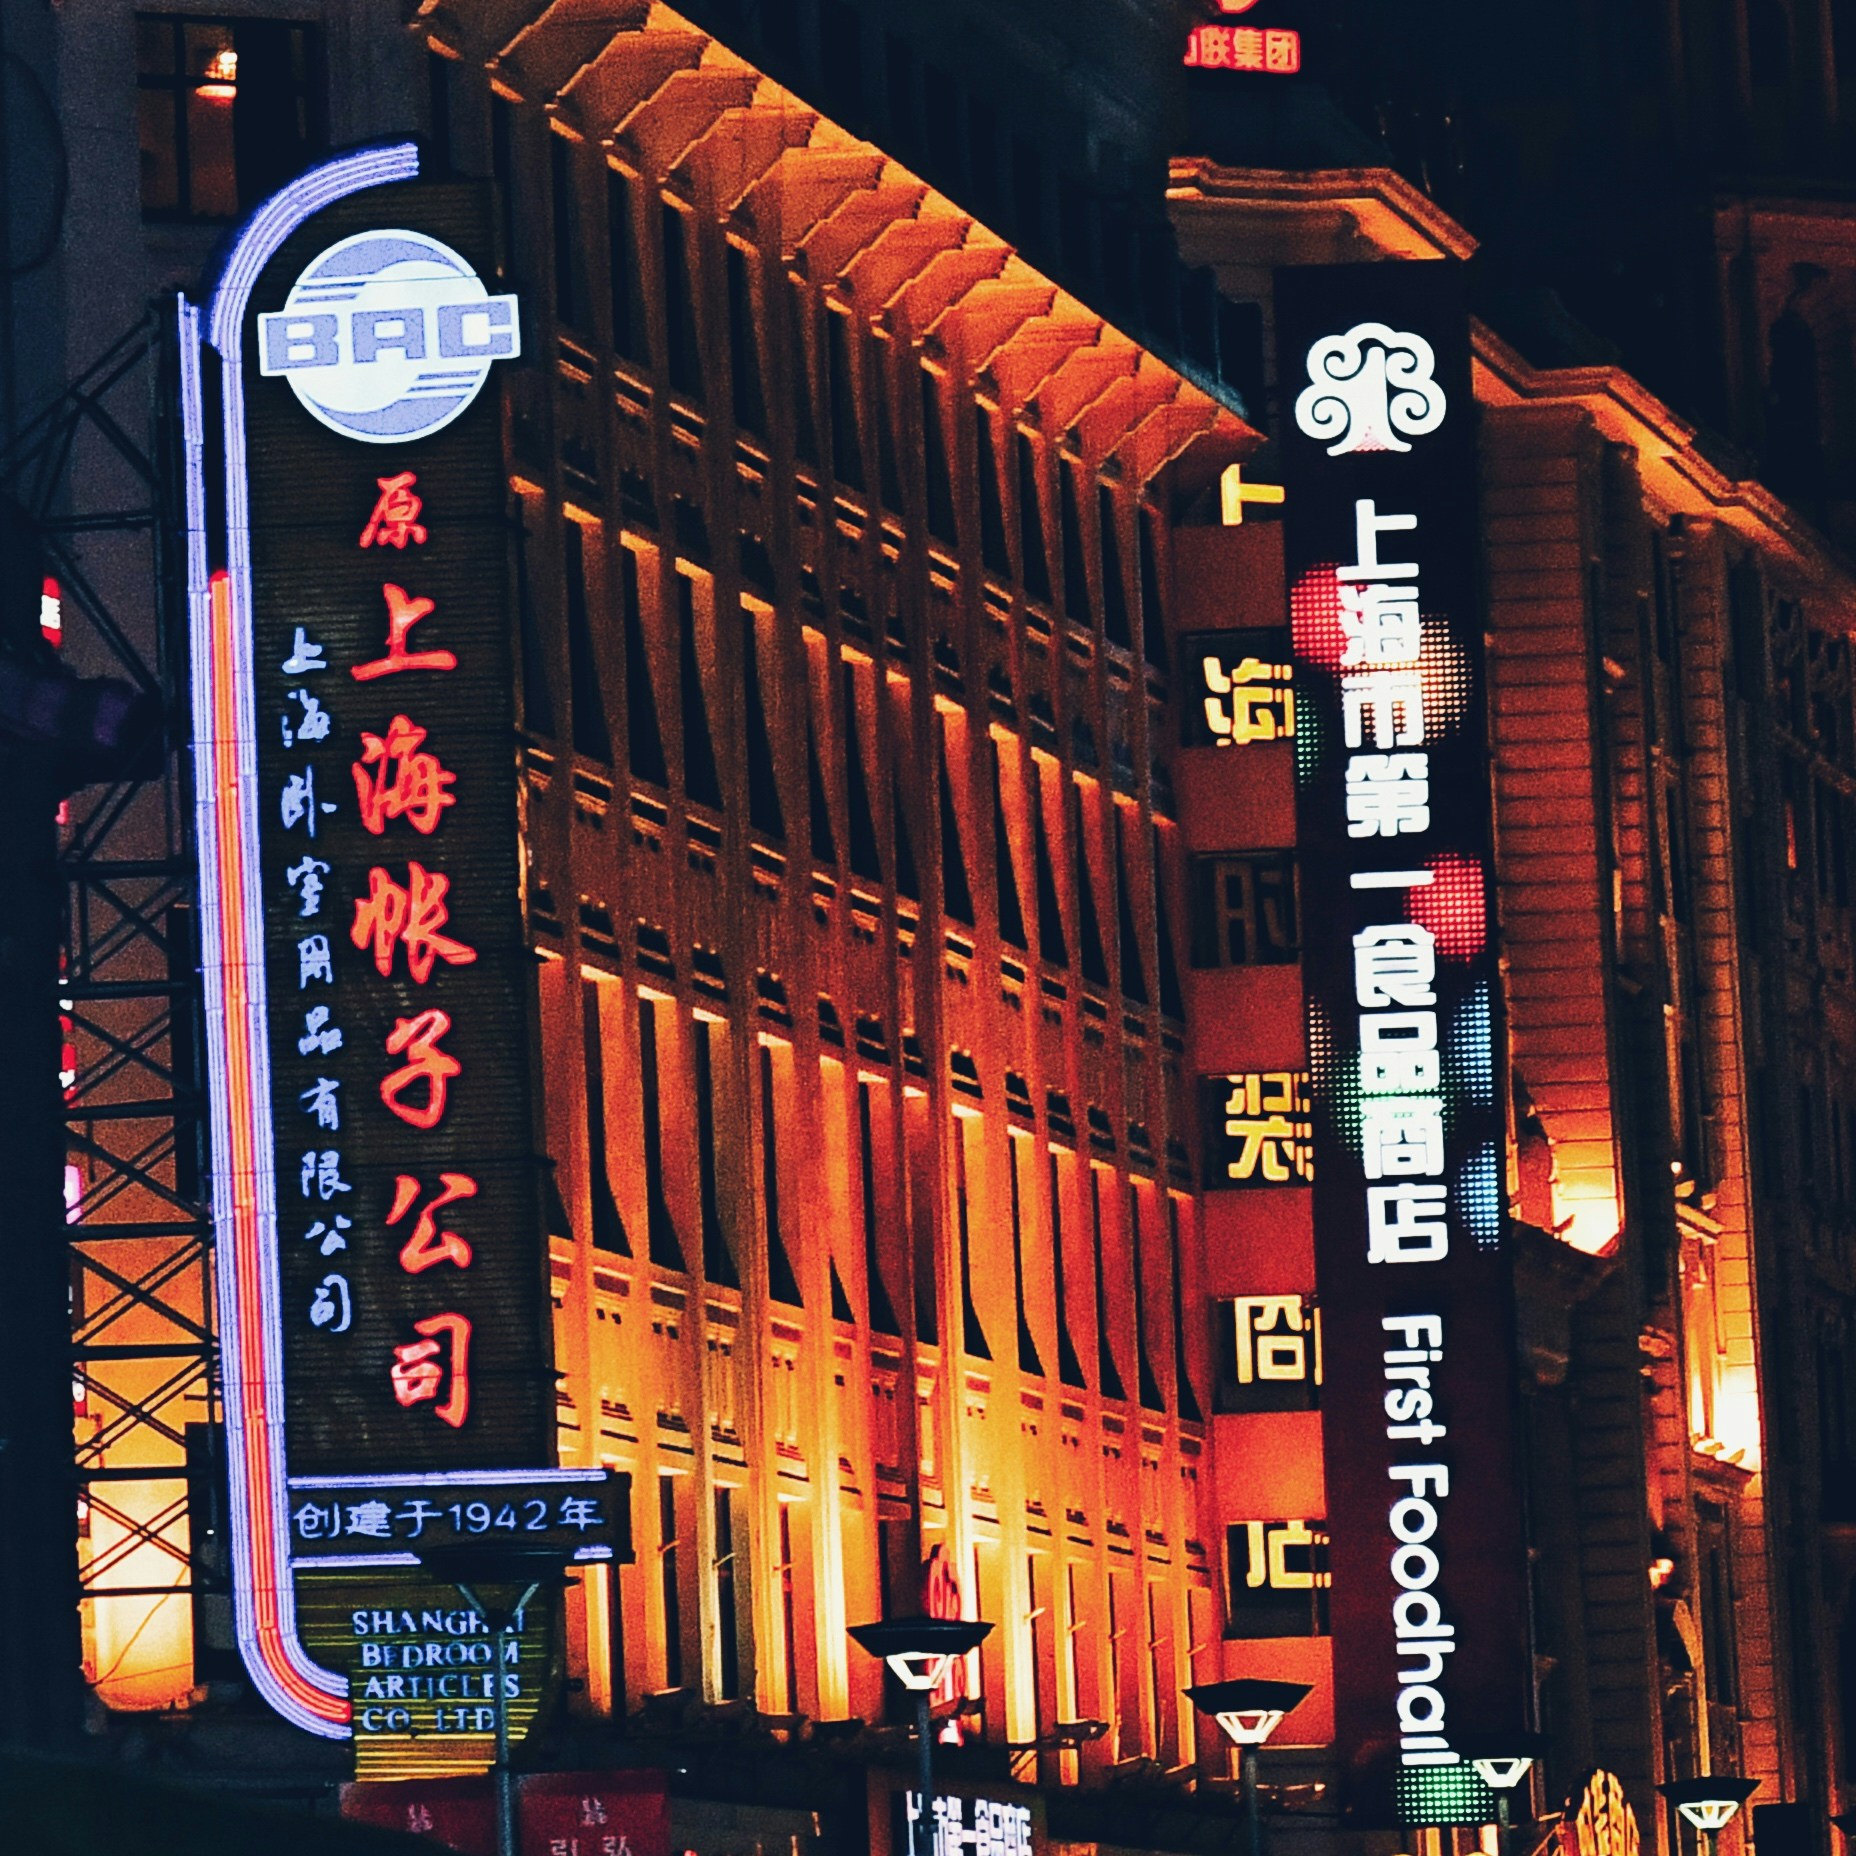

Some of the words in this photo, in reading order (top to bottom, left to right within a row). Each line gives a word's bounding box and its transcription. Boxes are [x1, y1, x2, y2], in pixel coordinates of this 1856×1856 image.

[1183, 24, 1301, 74] 联集团
[265, 300, 514, 372] BAC
[1335, 498, 1450, 1264] 上海市第一食品商店
[1382, 1314, 1448, 1445] First
[351, 1608, 525, 1636] SHANGHI
[1388, 1463, 1460, 1767] Foodhall
